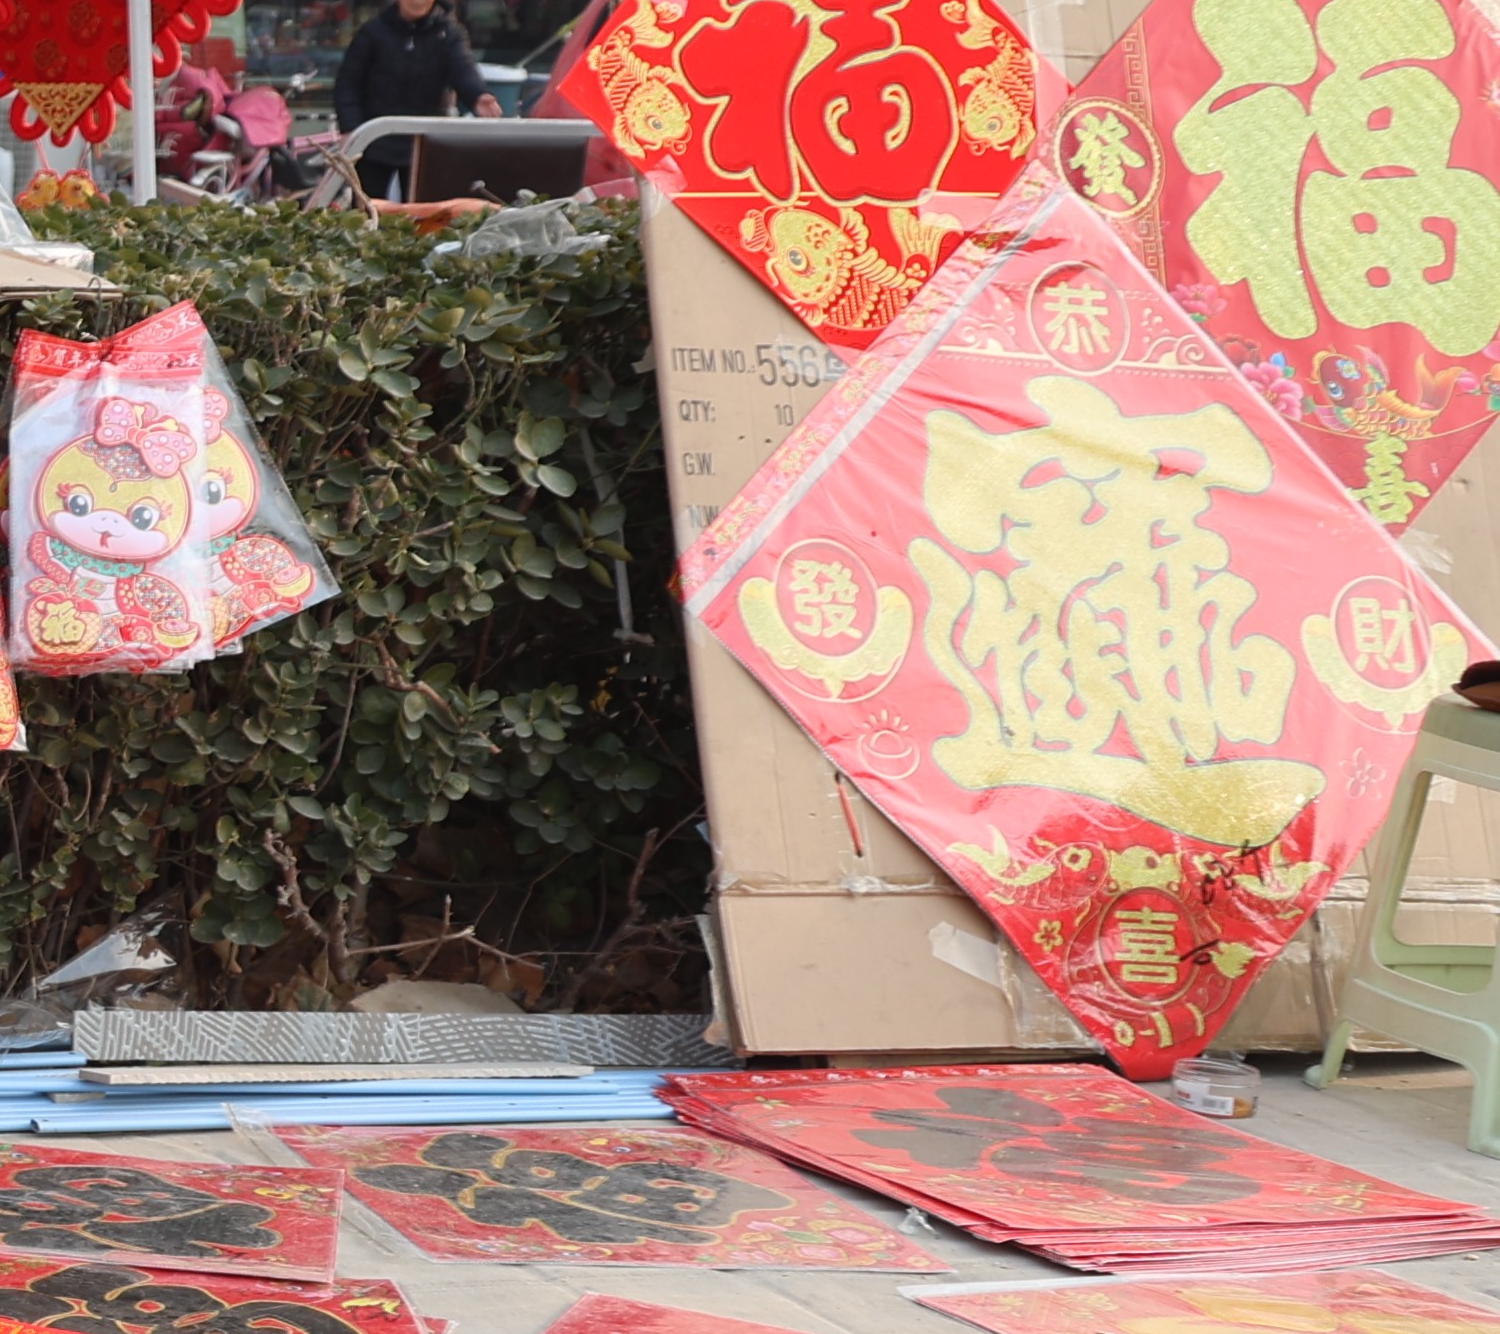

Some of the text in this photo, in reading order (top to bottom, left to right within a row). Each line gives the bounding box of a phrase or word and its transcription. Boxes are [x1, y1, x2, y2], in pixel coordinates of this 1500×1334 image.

[1040, 280, 1112, 354] 恭
[671, 347, 717, 373] ITEM
[679, 399, 717, 423] QTY:
[35, 601, 88, 645] 福
[786, 556, 863, 643] 發
[1349, 595, 1419, 675] 財
